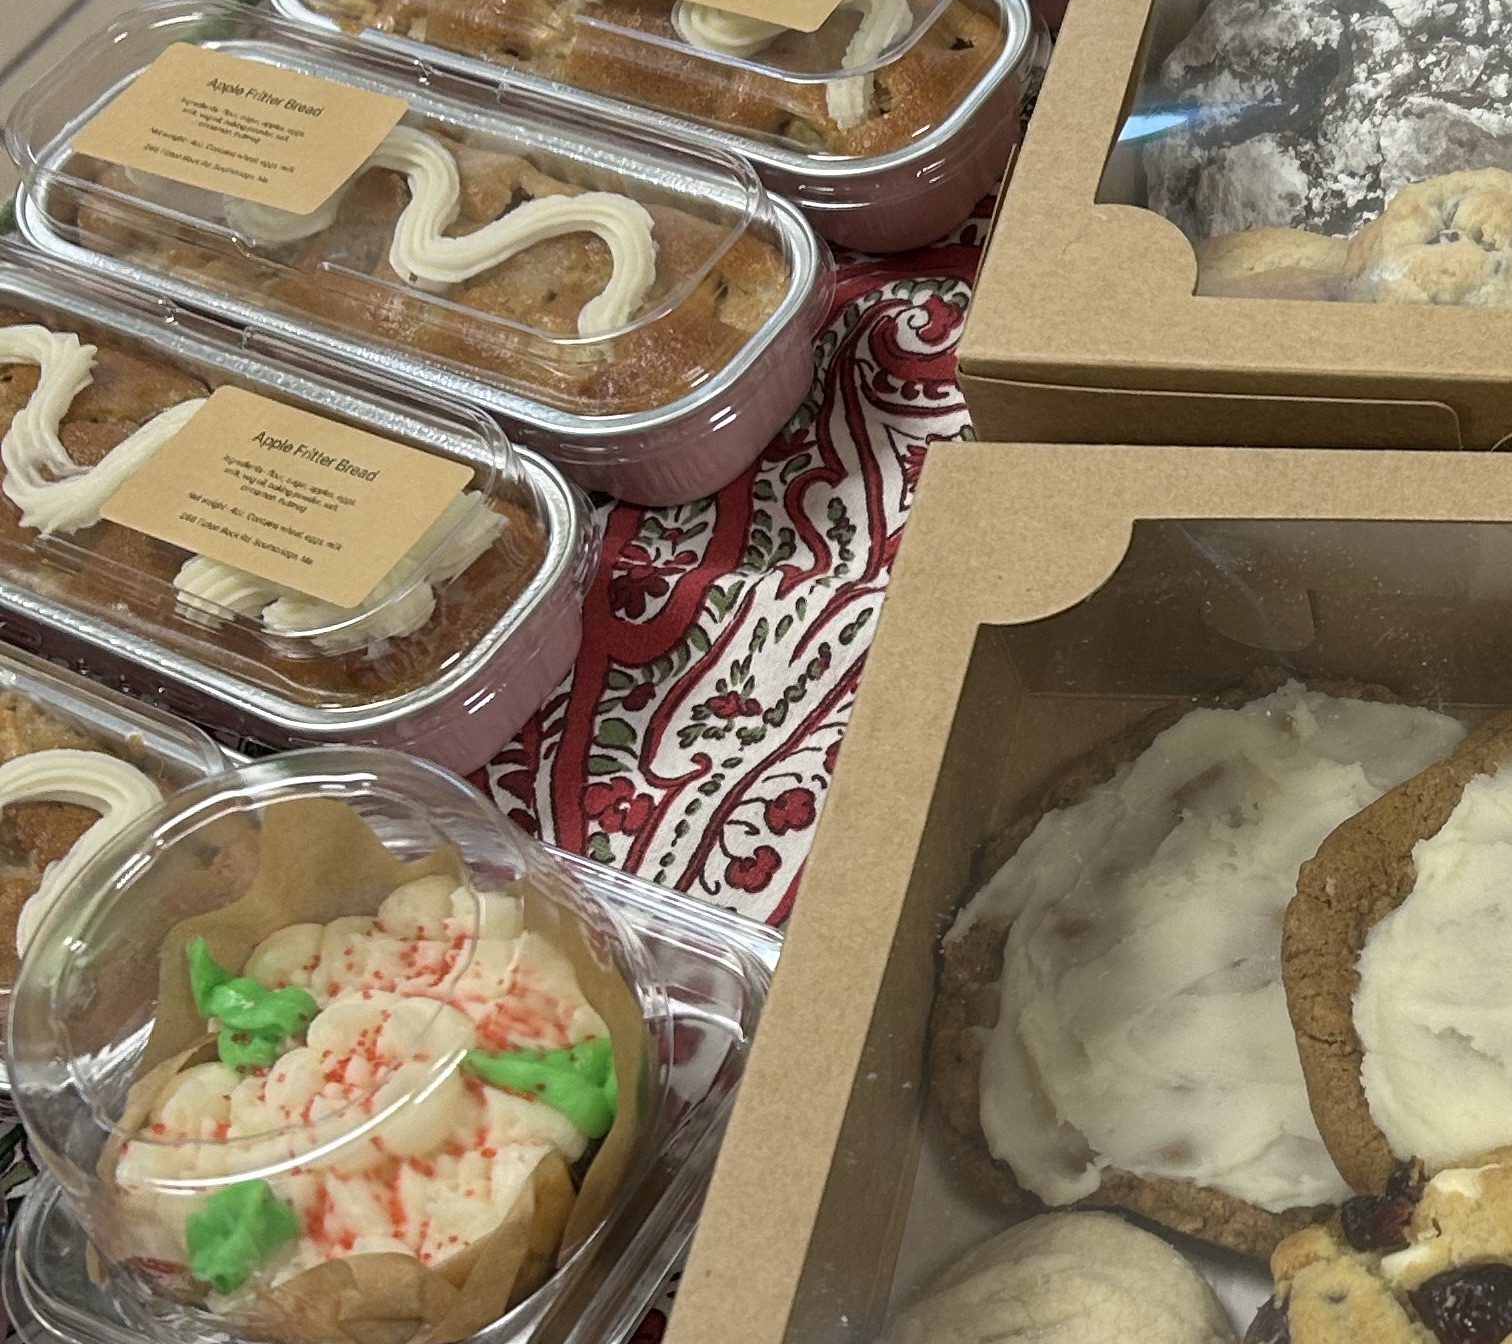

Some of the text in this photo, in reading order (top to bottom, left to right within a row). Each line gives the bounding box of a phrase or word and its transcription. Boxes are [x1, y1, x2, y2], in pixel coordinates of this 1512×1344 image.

[206, 78, 324, 117] Apple Fritter Bread
[252, 432, 379, 481] Apple Fritter Bread
